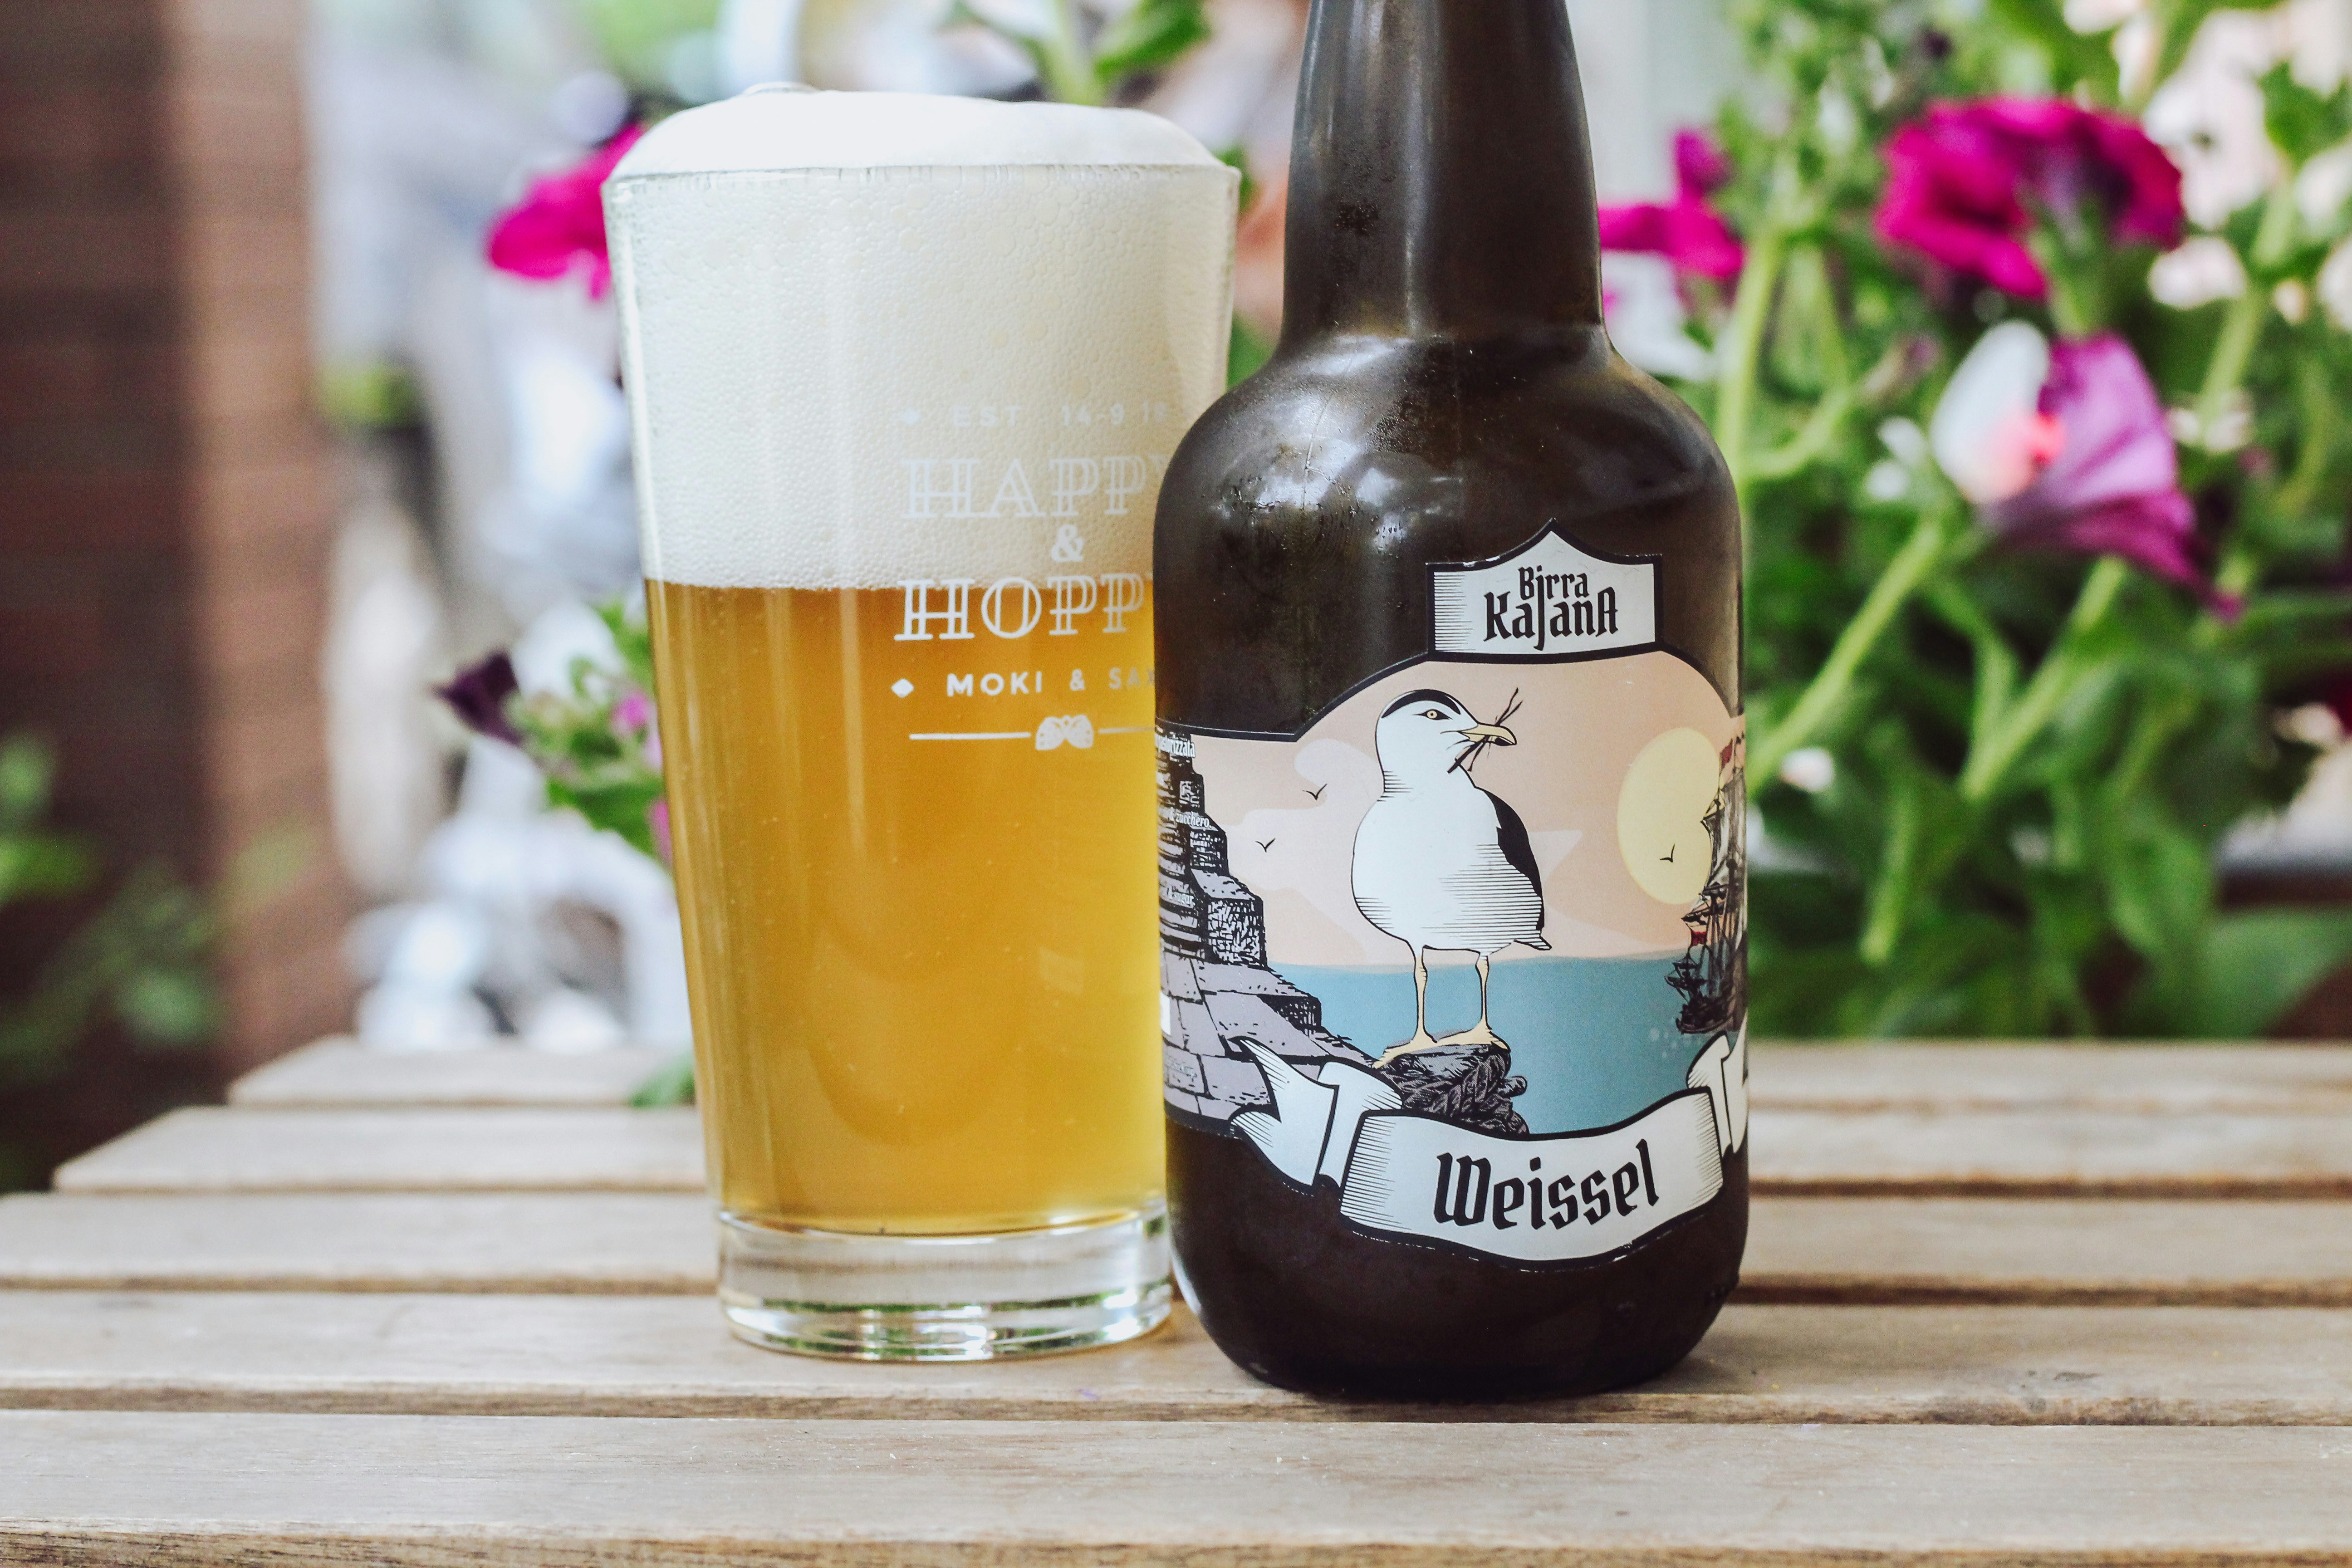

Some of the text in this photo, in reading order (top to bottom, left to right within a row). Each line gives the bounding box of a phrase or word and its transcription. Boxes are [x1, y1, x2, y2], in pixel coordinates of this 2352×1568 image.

[1050, 524, 1084, 563] &
[1518, 565, 1590, 601] Birra
[894, 573, 1153, 641] HOPP
[946, 671, 1042, 697] MOKI
[1069, 668, 1085, 691] &
[1433, 1138, 1660, 1230] Weissel
